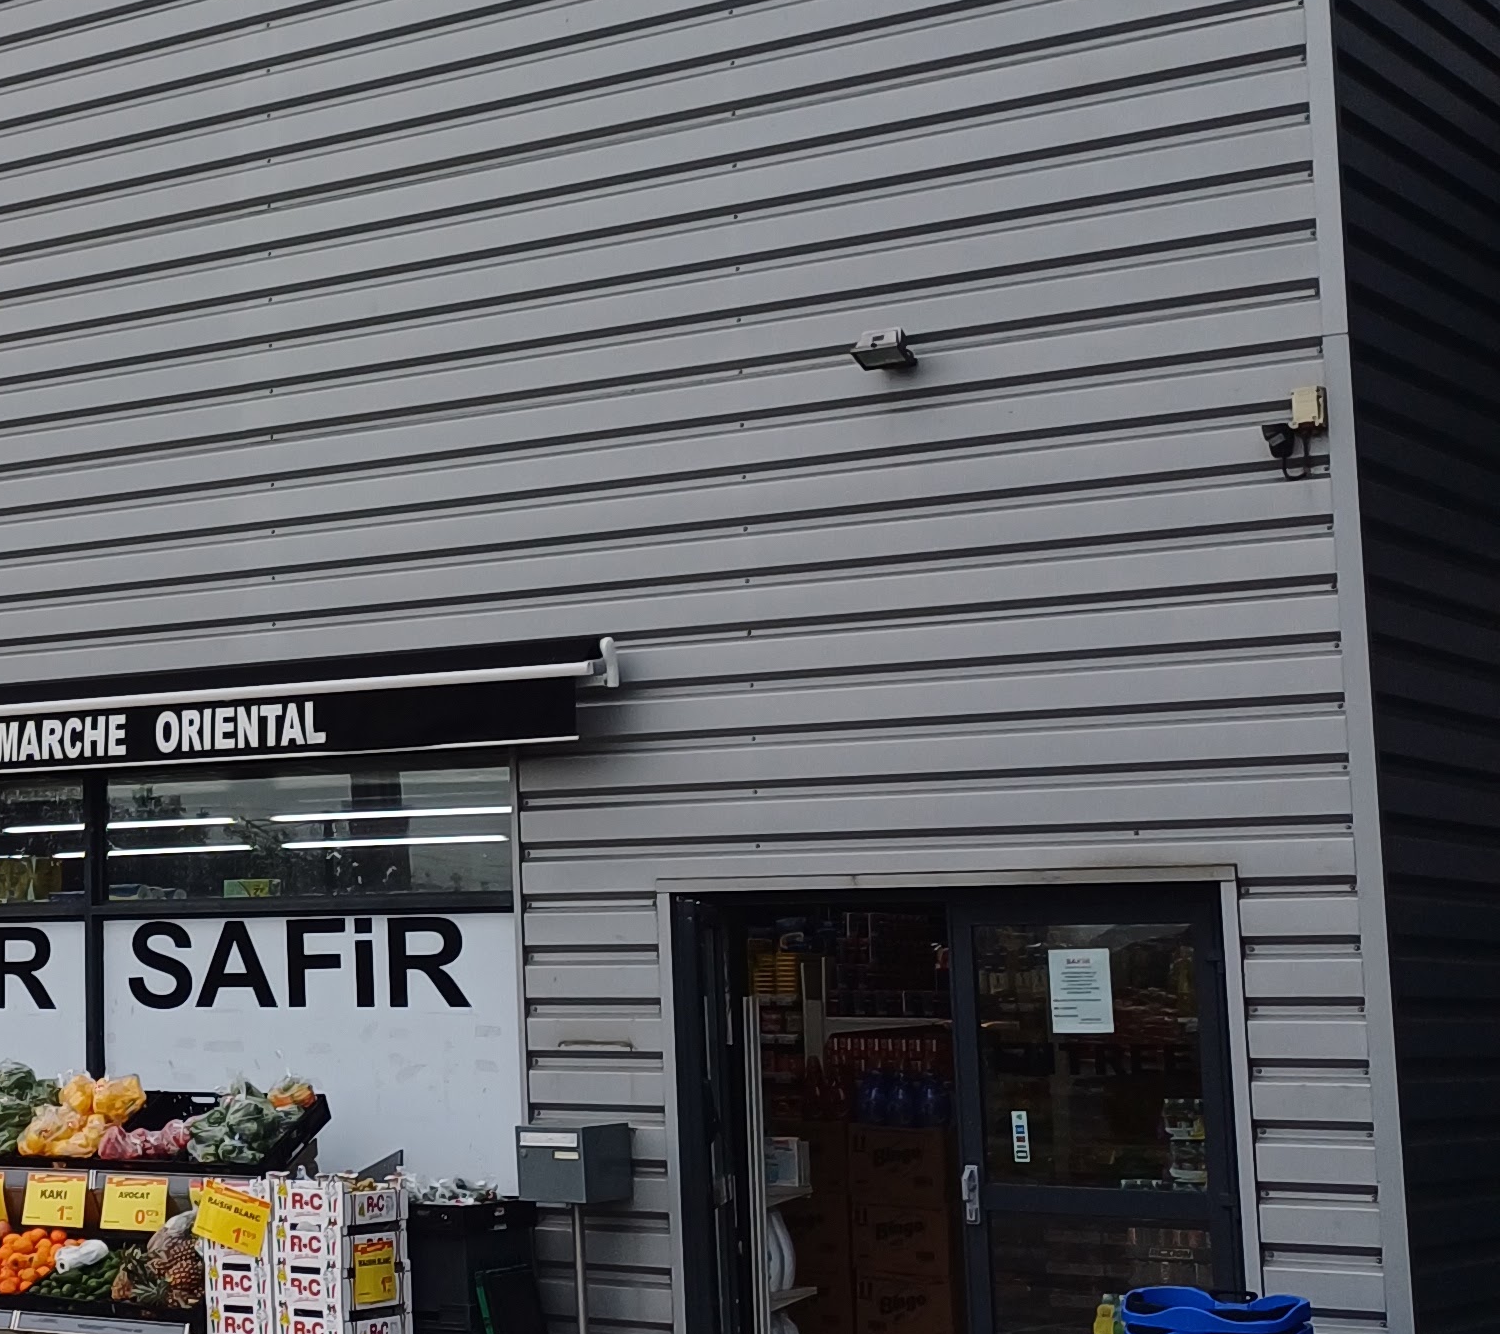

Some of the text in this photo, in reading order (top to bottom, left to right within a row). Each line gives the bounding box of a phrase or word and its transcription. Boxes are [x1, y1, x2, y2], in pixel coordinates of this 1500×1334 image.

[155, 701, 327, 752] ORIENTAL
[40, 1189, 67, 1200] KAKI
[234, 1206, 261, 1223] BLANC
